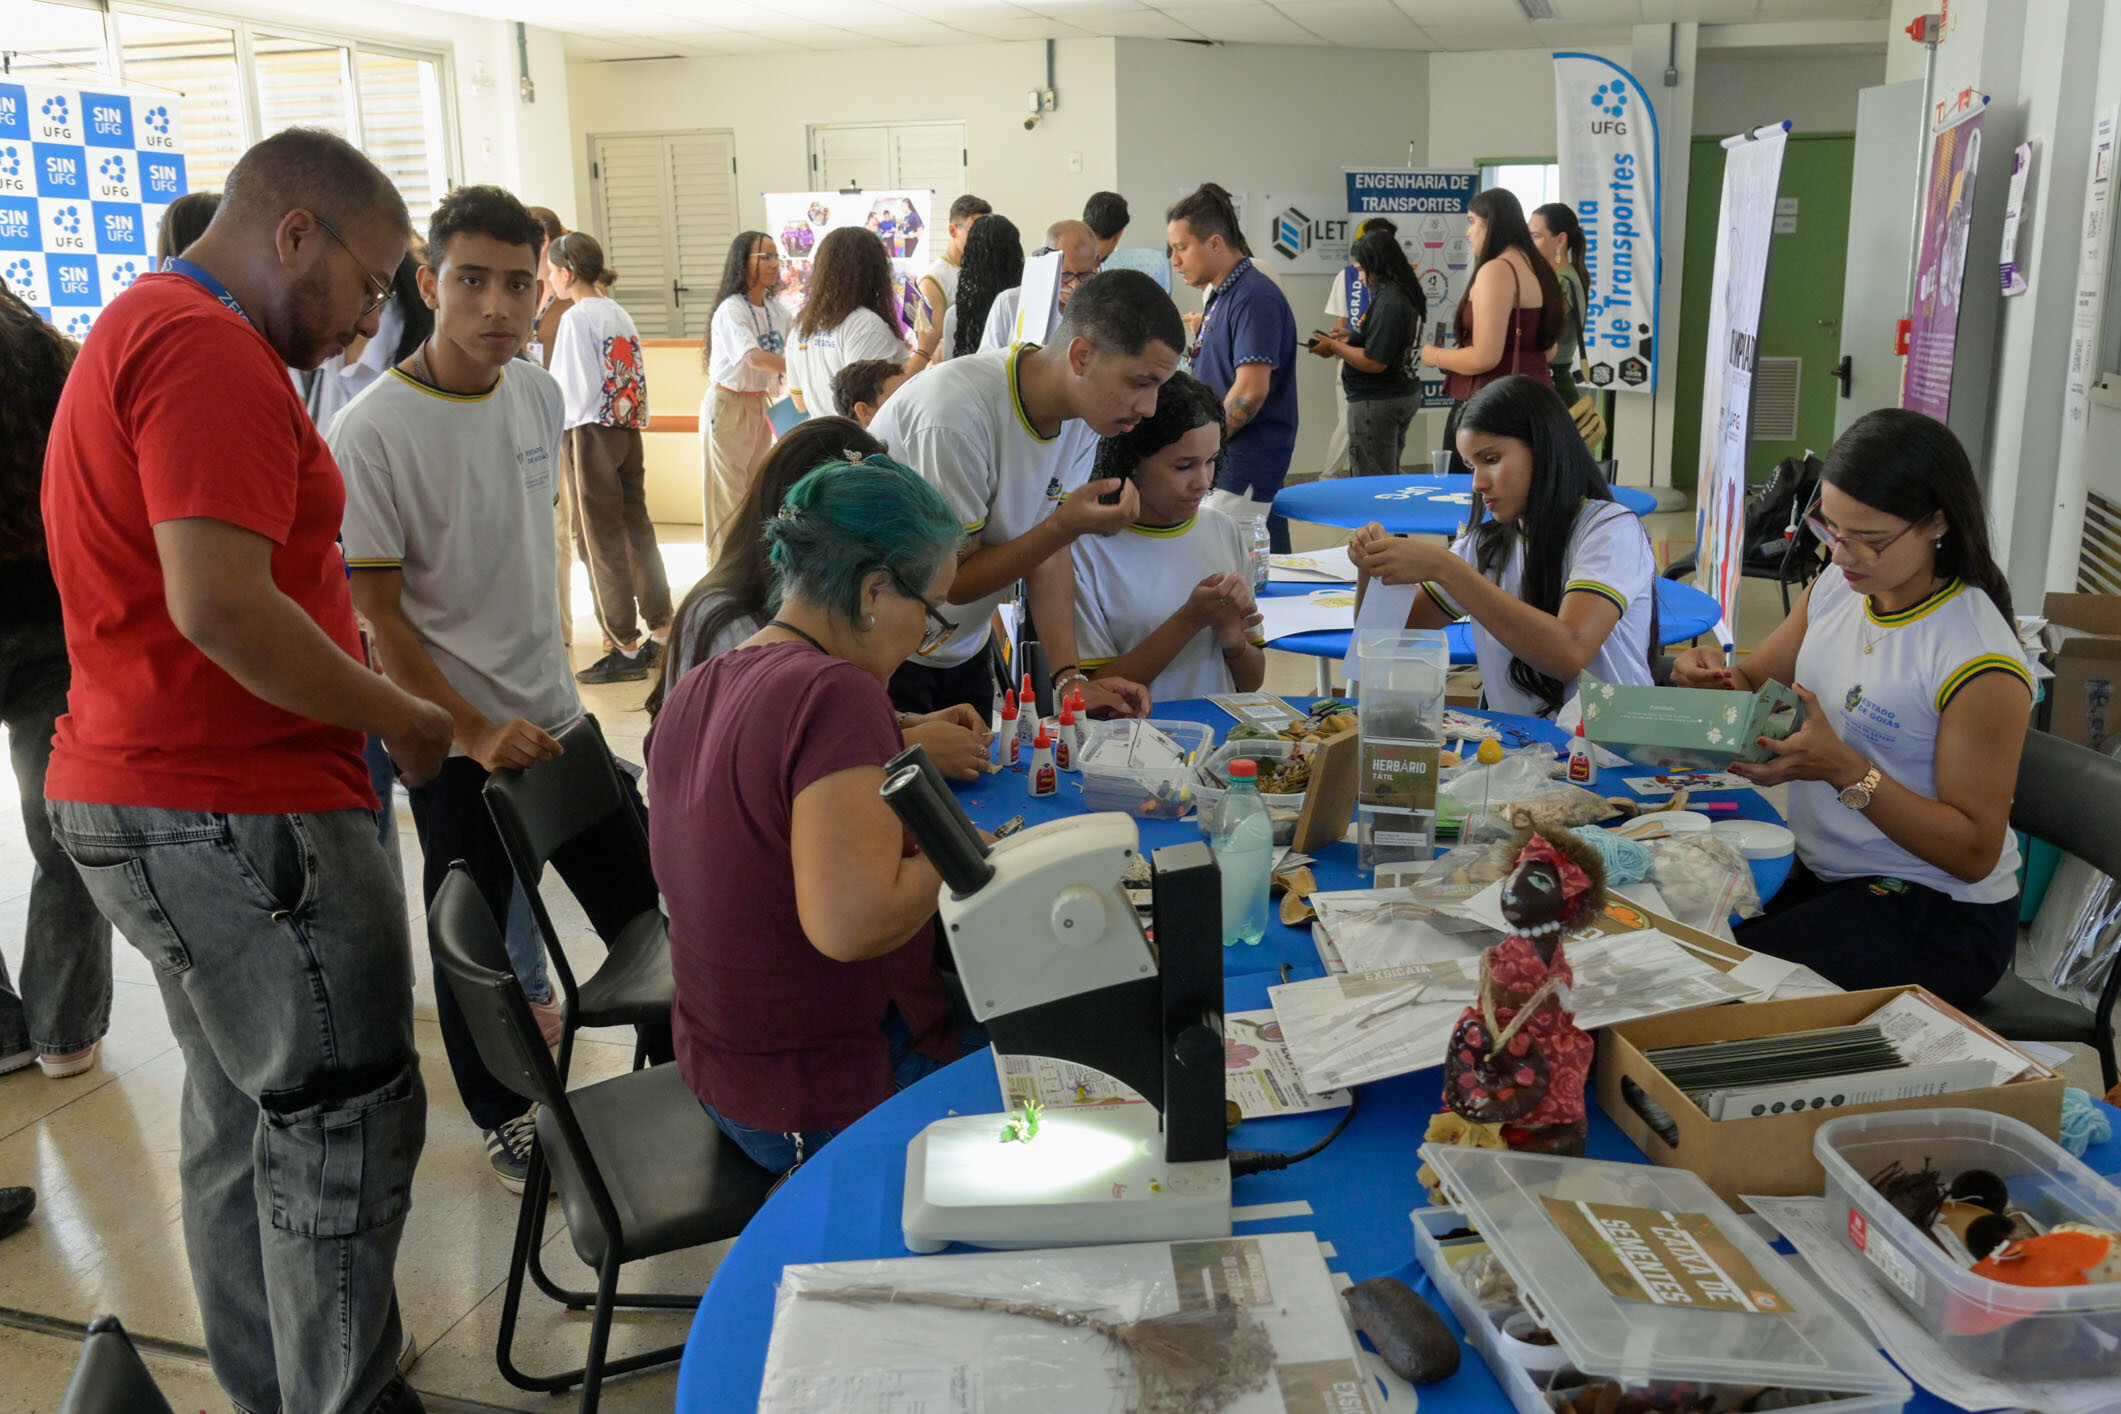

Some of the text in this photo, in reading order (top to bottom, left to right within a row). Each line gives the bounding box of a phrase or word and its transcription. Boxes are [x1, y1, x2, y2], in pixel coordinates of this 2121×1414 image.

[93, 106, 122, 124] SIN
[43, 126, 72, 139] UFG
[95, 122, 122, 136] UFG
[1591, 121, 1627, 135] UFG
[146, 136, 173, 148] UFG
[46, 156, 76, 174] SIN
[149, 165, 177, 180] SIN
[48, 172, 76, 186] UFG
[151, 179, 177, 192] UFG
[1355, 174, 1469, 190] ENGENHARIA DE
[101, 185, 129, 197] UFG
[1361, 197, 1461, 212] TRANSPORTES
[0, 209, 29, 225] SIN
[104, 215, 134, 230] SIN
[0, 225, 29, 238] UFG
[107, 230, 134, 242] UFG
[1315, 220, 1348, 240] LET
[1604, 153, 1640, 308] Transportes
[55, 237, 84, 248] UFG
[58, 267, 88, 282] SIN
[61, 281, 88, 294] UFG
[1601, 318, 1632, 349] de
[1861, 697, 1896, 719] ESTADO
[1372, 759, 1427, 774] HERBÁRIO
[1372, 772, 1394, 781] TÁTIL
[1600, 1218, 1694, 1303] SEMENTES
[1649, 1226, 1741, 1303] CAIXA DE
[1332, 1382, 1366, 1414] EXSI
